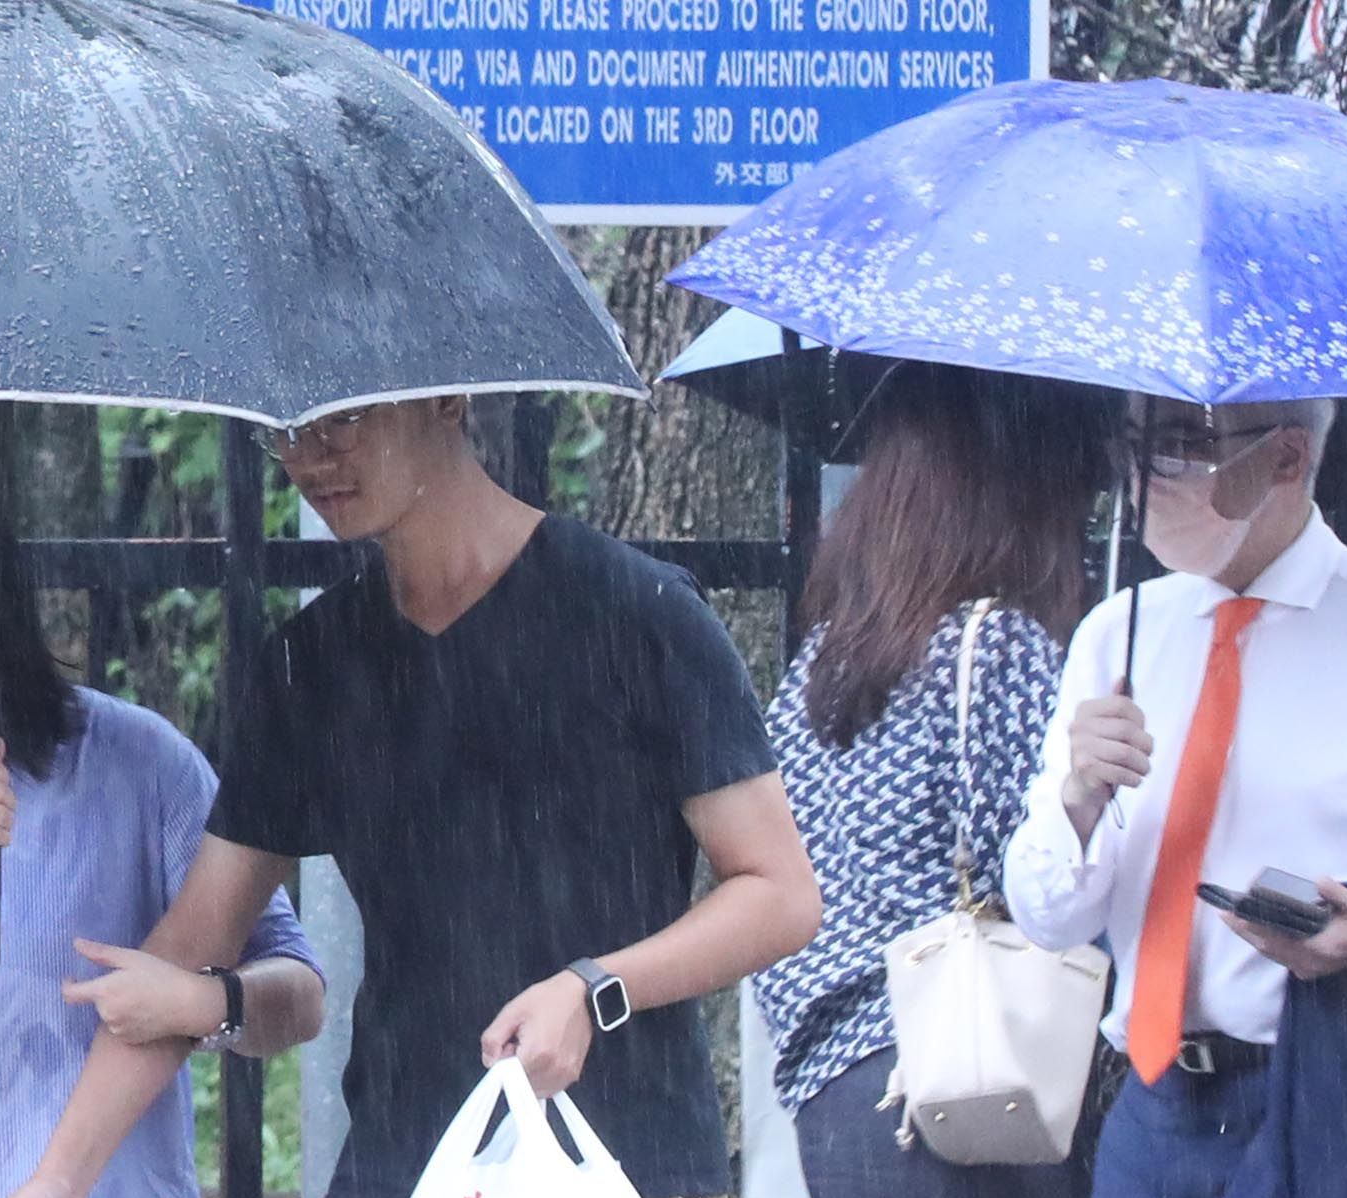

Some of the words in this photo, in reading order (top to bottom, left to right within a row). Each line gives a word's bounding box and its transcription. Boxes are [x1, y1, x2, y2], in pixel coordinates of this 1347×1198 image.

[384, 0, 529, 31] APPLICATIONS
[540, 0, 610, 31] PLEASE
[621, 0, 720, 31] PROCEED
[731, 0, 758, 31] TO
[770, 0, 804, 31] THE
[816, 0, 908, 32] GROUND
[920, 0, 994, 37] FLOOR,
[475, 49, 522, 86] VISA
[531, 49, 577, 86] AND
[587, 49, 706, 87] DOCUMENT
[716, 50, 889, 88] AUTHENTICATION
[900, 51, 994, 88] SERVICES
[496, 106, 590, 143] LOCATED
[601, 106, 634, 143] ON
[644, 106, 681, 144] THE
[692, 106, 733, 144] 3RD
[750, 106, 819, 144] FLOOR
